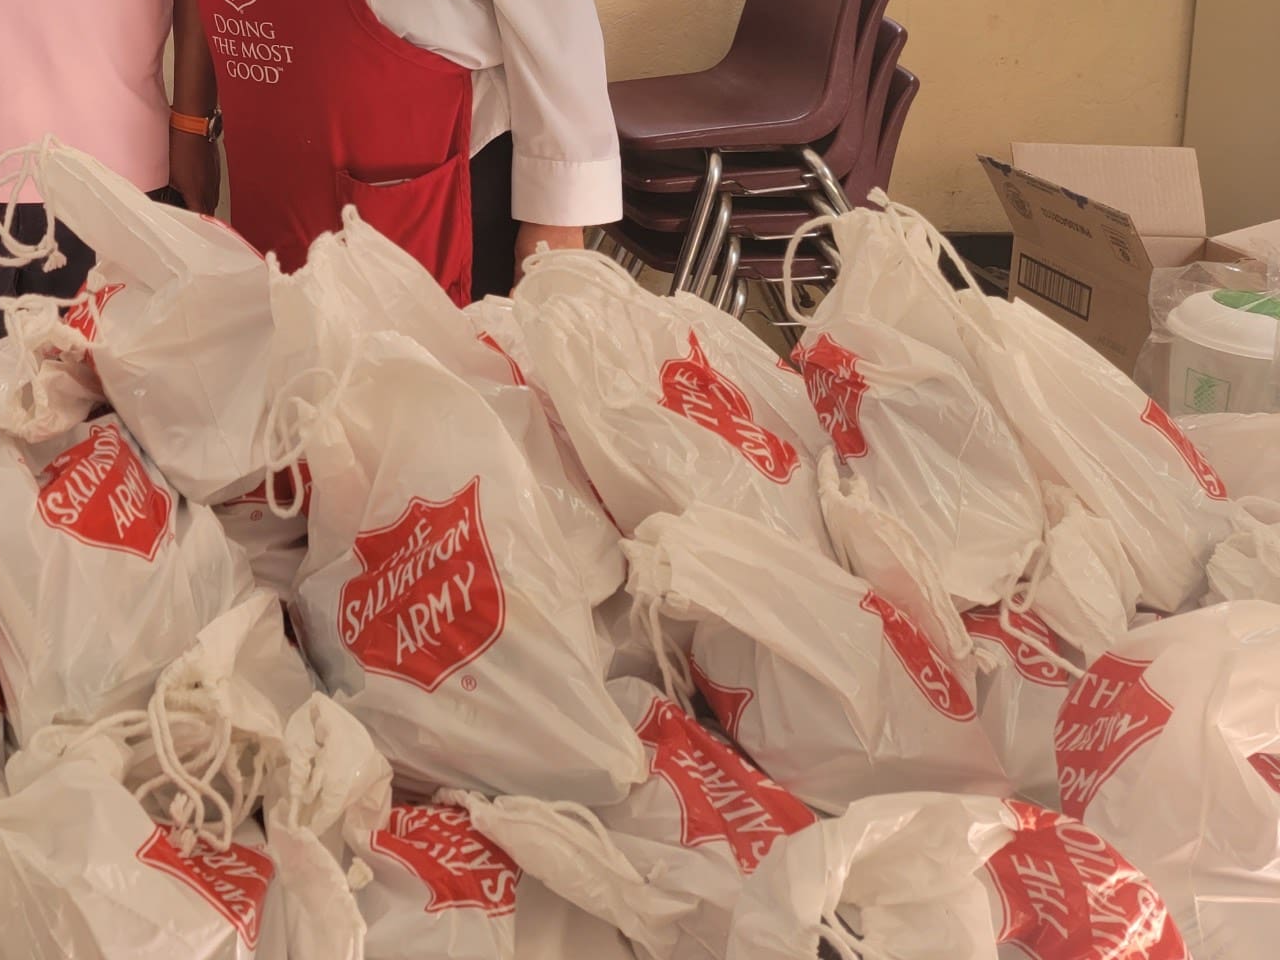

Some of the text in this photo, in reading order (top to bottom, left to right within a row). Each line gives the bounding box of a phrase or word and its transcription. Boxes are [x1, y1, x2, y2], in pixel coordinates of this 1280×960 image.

[212, 35, 294, 63] THE MOST
[214, 13, 275, 40] DOING
[108, 457, 148, 539] ARMY
[396, 560, 476, 666] ARMY
[1009, 852, 1070, 940] THE
